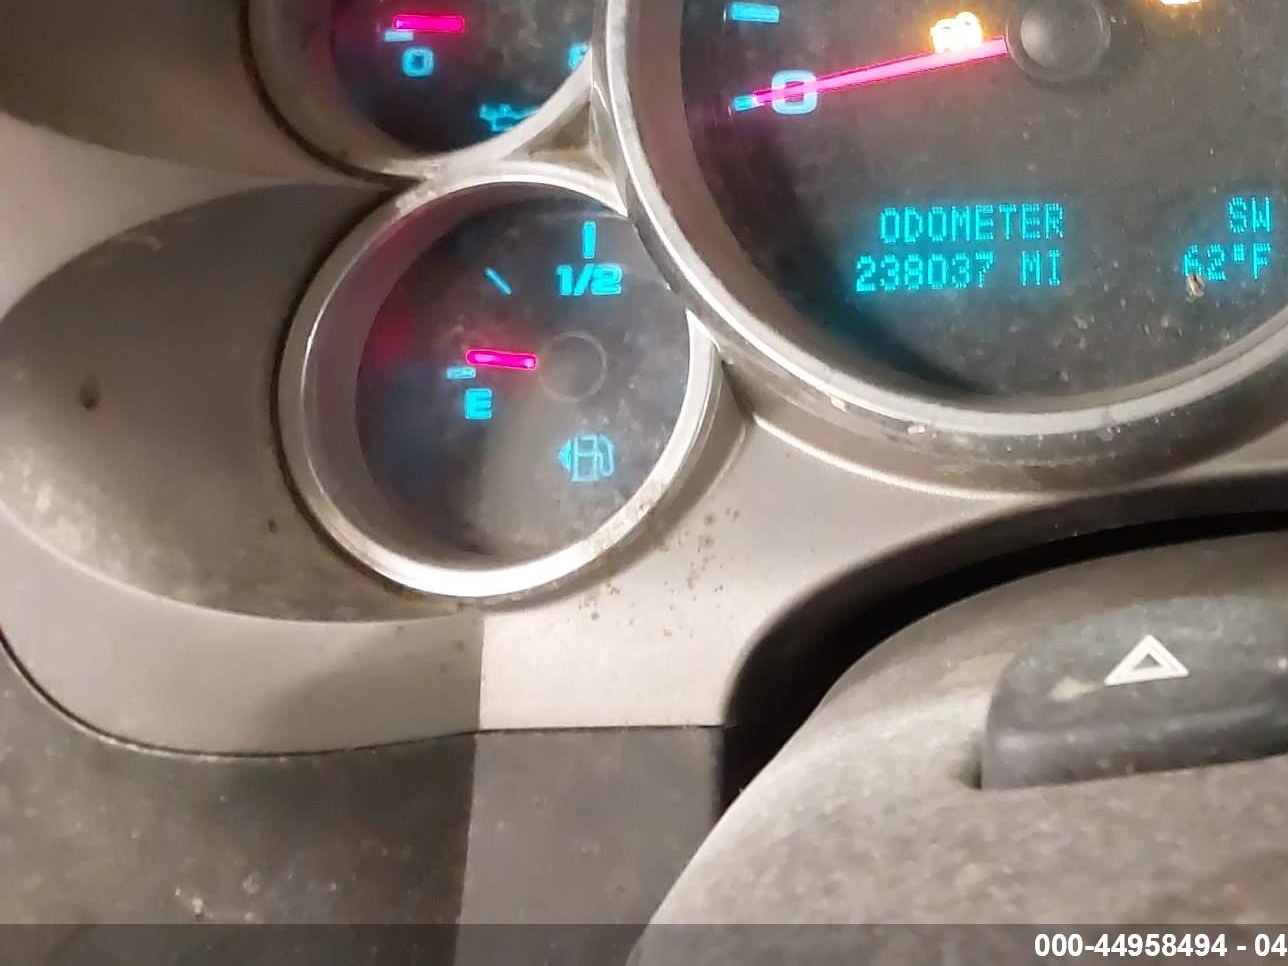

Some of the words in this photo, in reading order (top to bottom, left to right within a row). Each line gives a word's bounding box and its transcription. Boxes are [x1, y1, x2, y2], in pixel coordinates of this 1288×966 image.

[402, 47, 434, 77] 0
[769, 71, 818, 116] 0
[879, 202, 1065, 244] ODOMETER
[1227, 195, 1273, 234] SW
[556, 263, 624, 297] 1/2
[855, 250, 995, 293] 238037
[1020, 248, 1062, 288] MI
[463, 387, 493, 421] E
